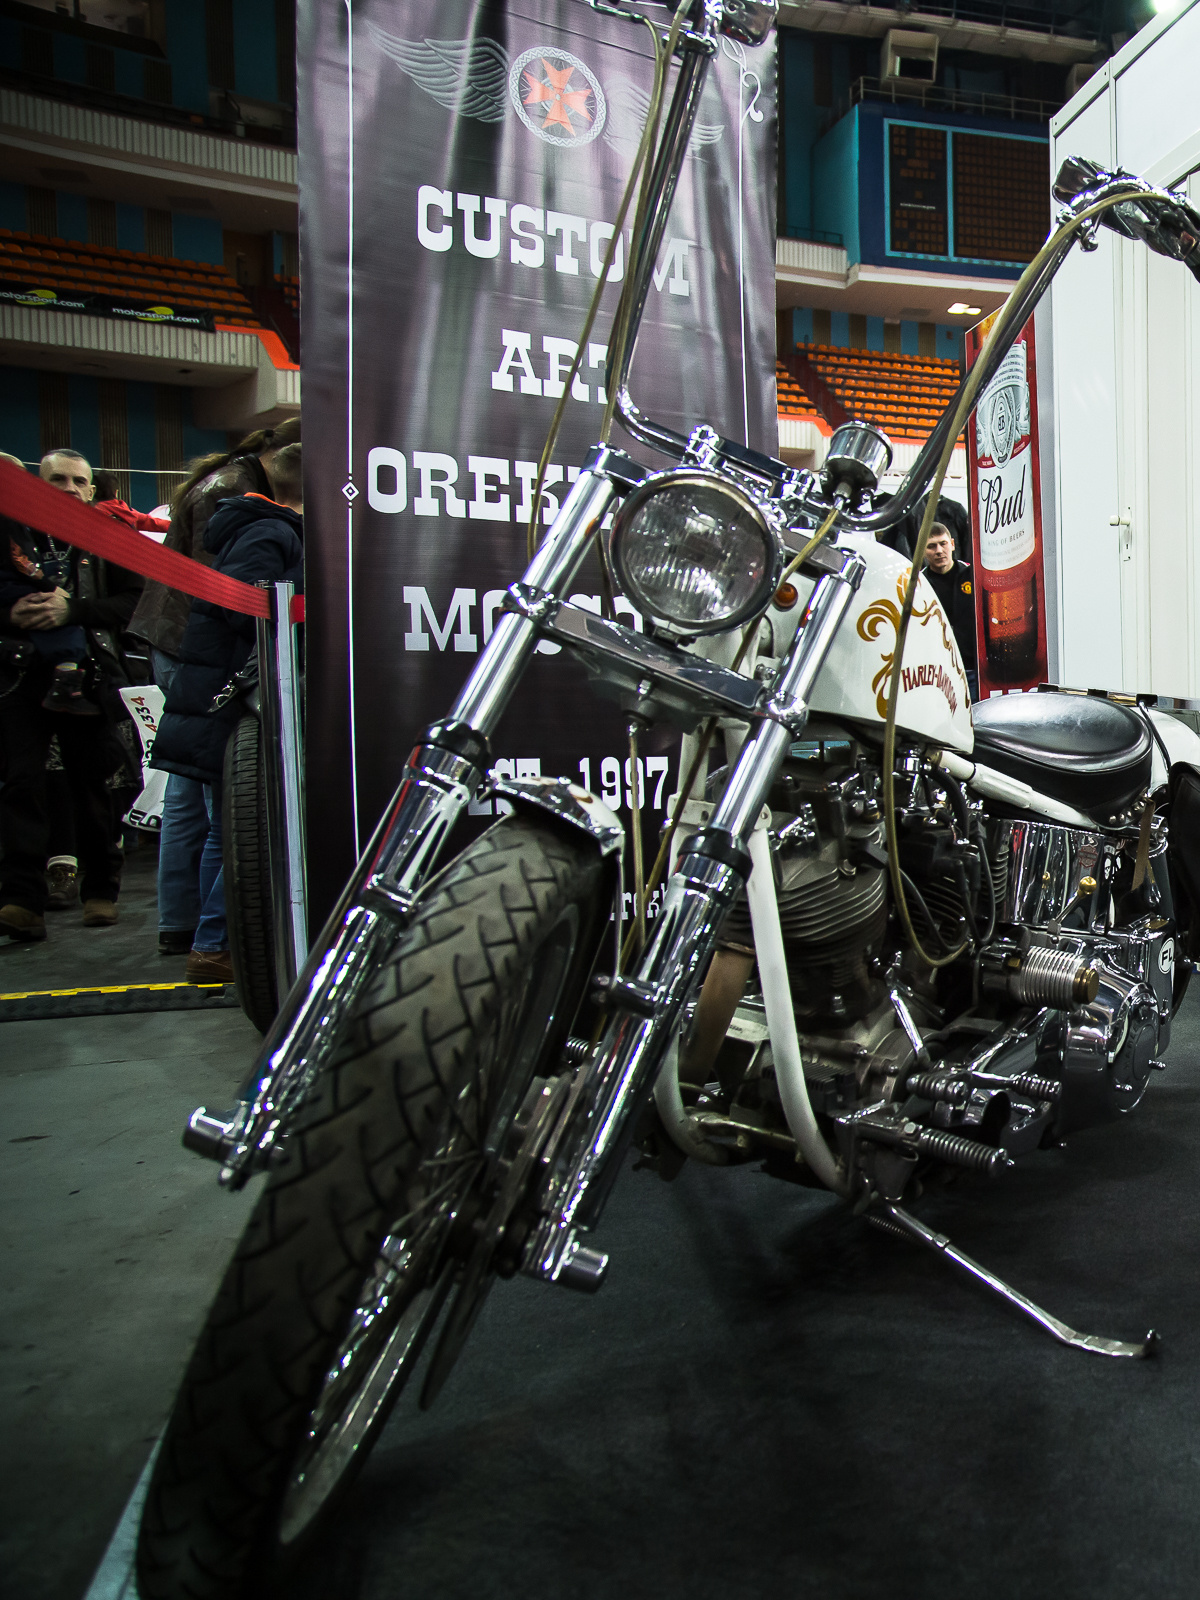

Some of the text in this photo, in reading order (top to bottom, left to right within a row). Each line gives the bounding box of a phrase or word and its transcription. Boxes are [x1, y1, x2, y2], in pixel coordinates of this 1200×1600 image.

[417, 184, 691, 297] CUSTOM
[112, 306, 200, 324] motorsport.com
[981, 464, 1026, 534] Bud
[1009, 530, 1025, 543] BEERS
[579, 756, 669, 812] 1997
[1161, 950, 1174, 966] FL
